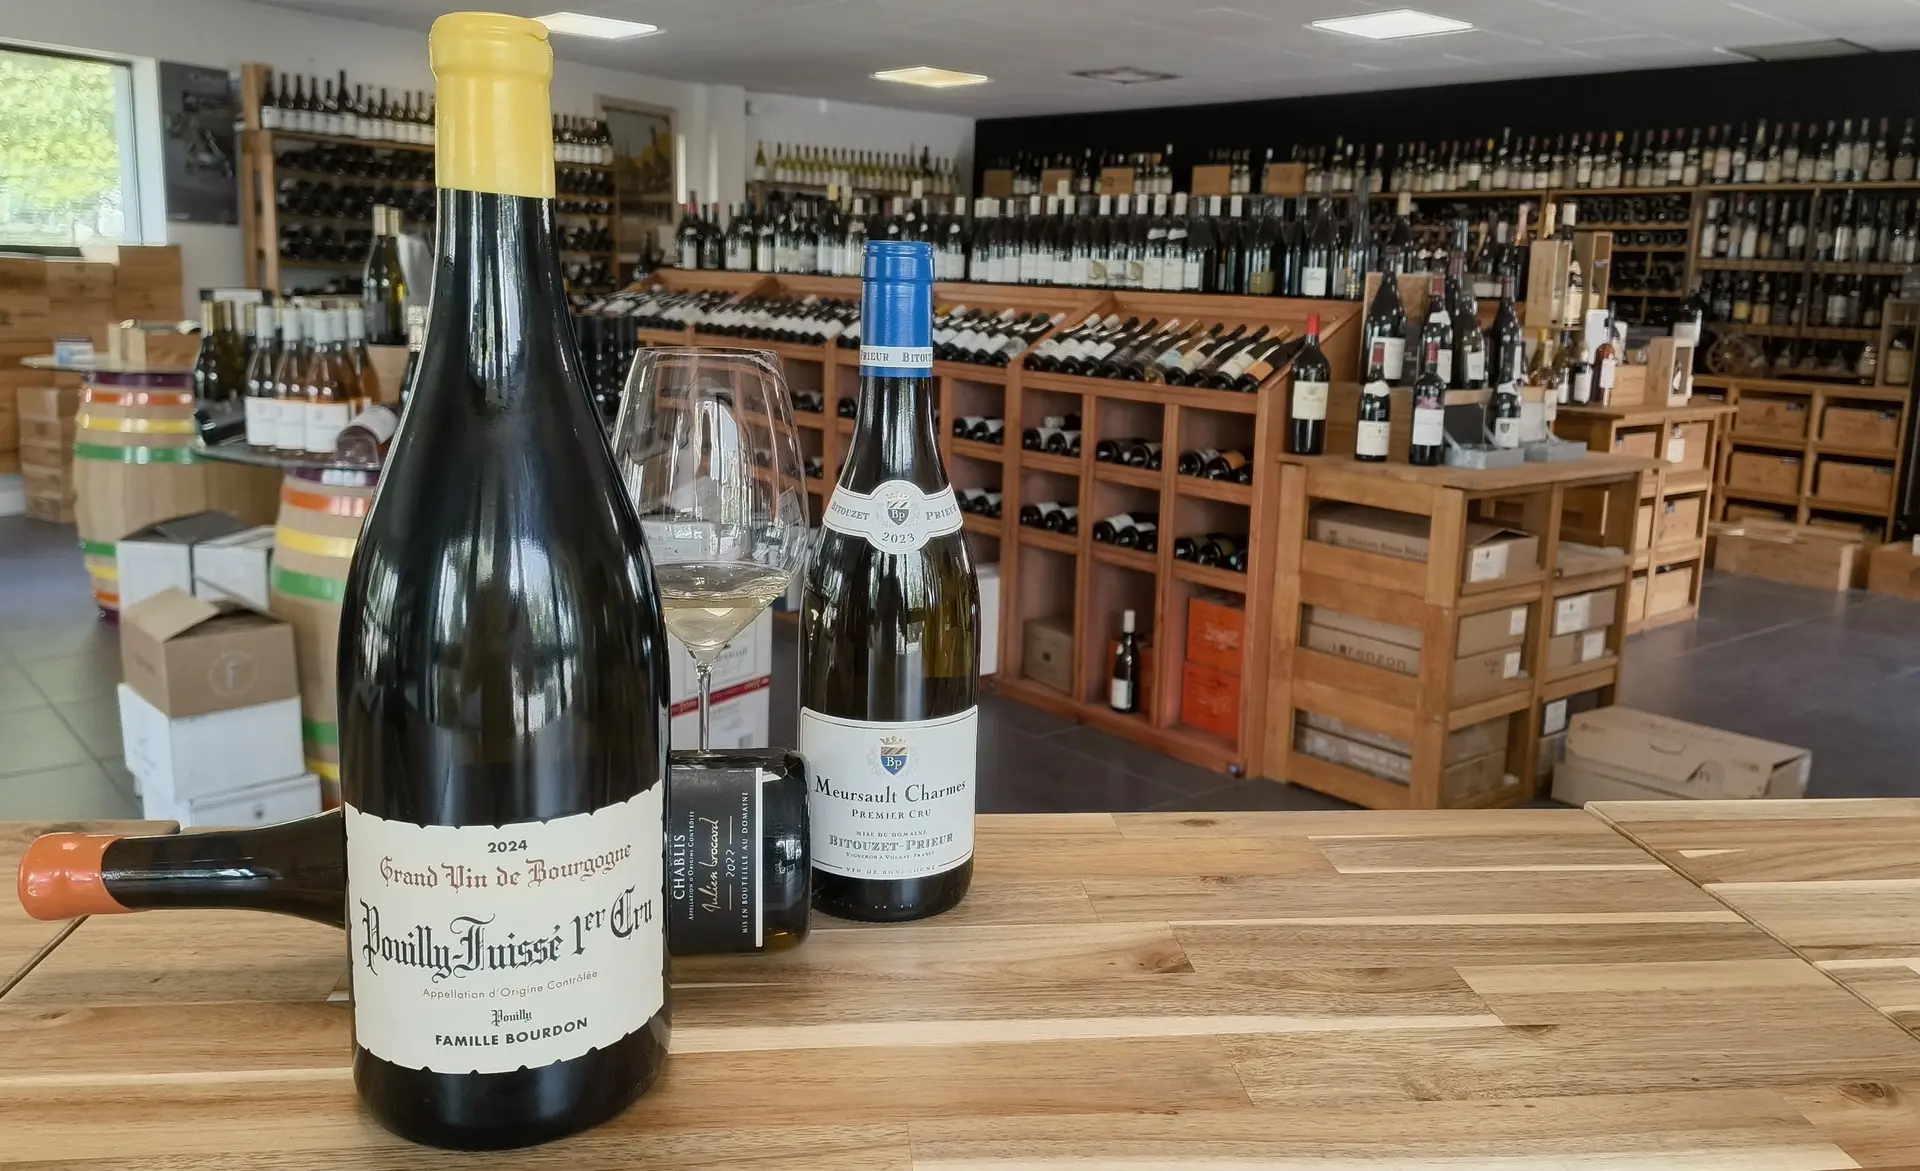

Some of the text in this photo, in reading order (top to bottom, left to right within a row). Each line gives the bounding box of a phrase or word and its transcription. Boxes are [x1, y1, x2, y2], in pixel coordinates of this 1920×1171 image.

[831, 501, 871, 521] BITOUZET
[881, 531, 915, 544] 2023
[814, 775, 967, 804] Meursault Charmes
[851, 808, 932, 820] PREMIER CRU
[486, 839, 529, 854] 2024
[828, 832, 954, 852] BITOUZET-PRIEUR
[891, 829, 928, 838] DOMAINE
[380, 844, 632, 894] Grand Vin de Bourgogne
[673, 834, 686, 900] CHABLIS
[725, 849, 736, 878] 2022
[741, 791, 749, 933] MIS EN BOUTEILLE AU DOMAINE
[359, 884, 653, 984] Pouilly-Fuissé 1er Cru
[422, 970, 598, 1000] Appellation d'Origine Contrôlée
[435, 1017, 588, 1047] FAMILLE BOURDON
[490, 1008, 533, 1027] Pouilly
